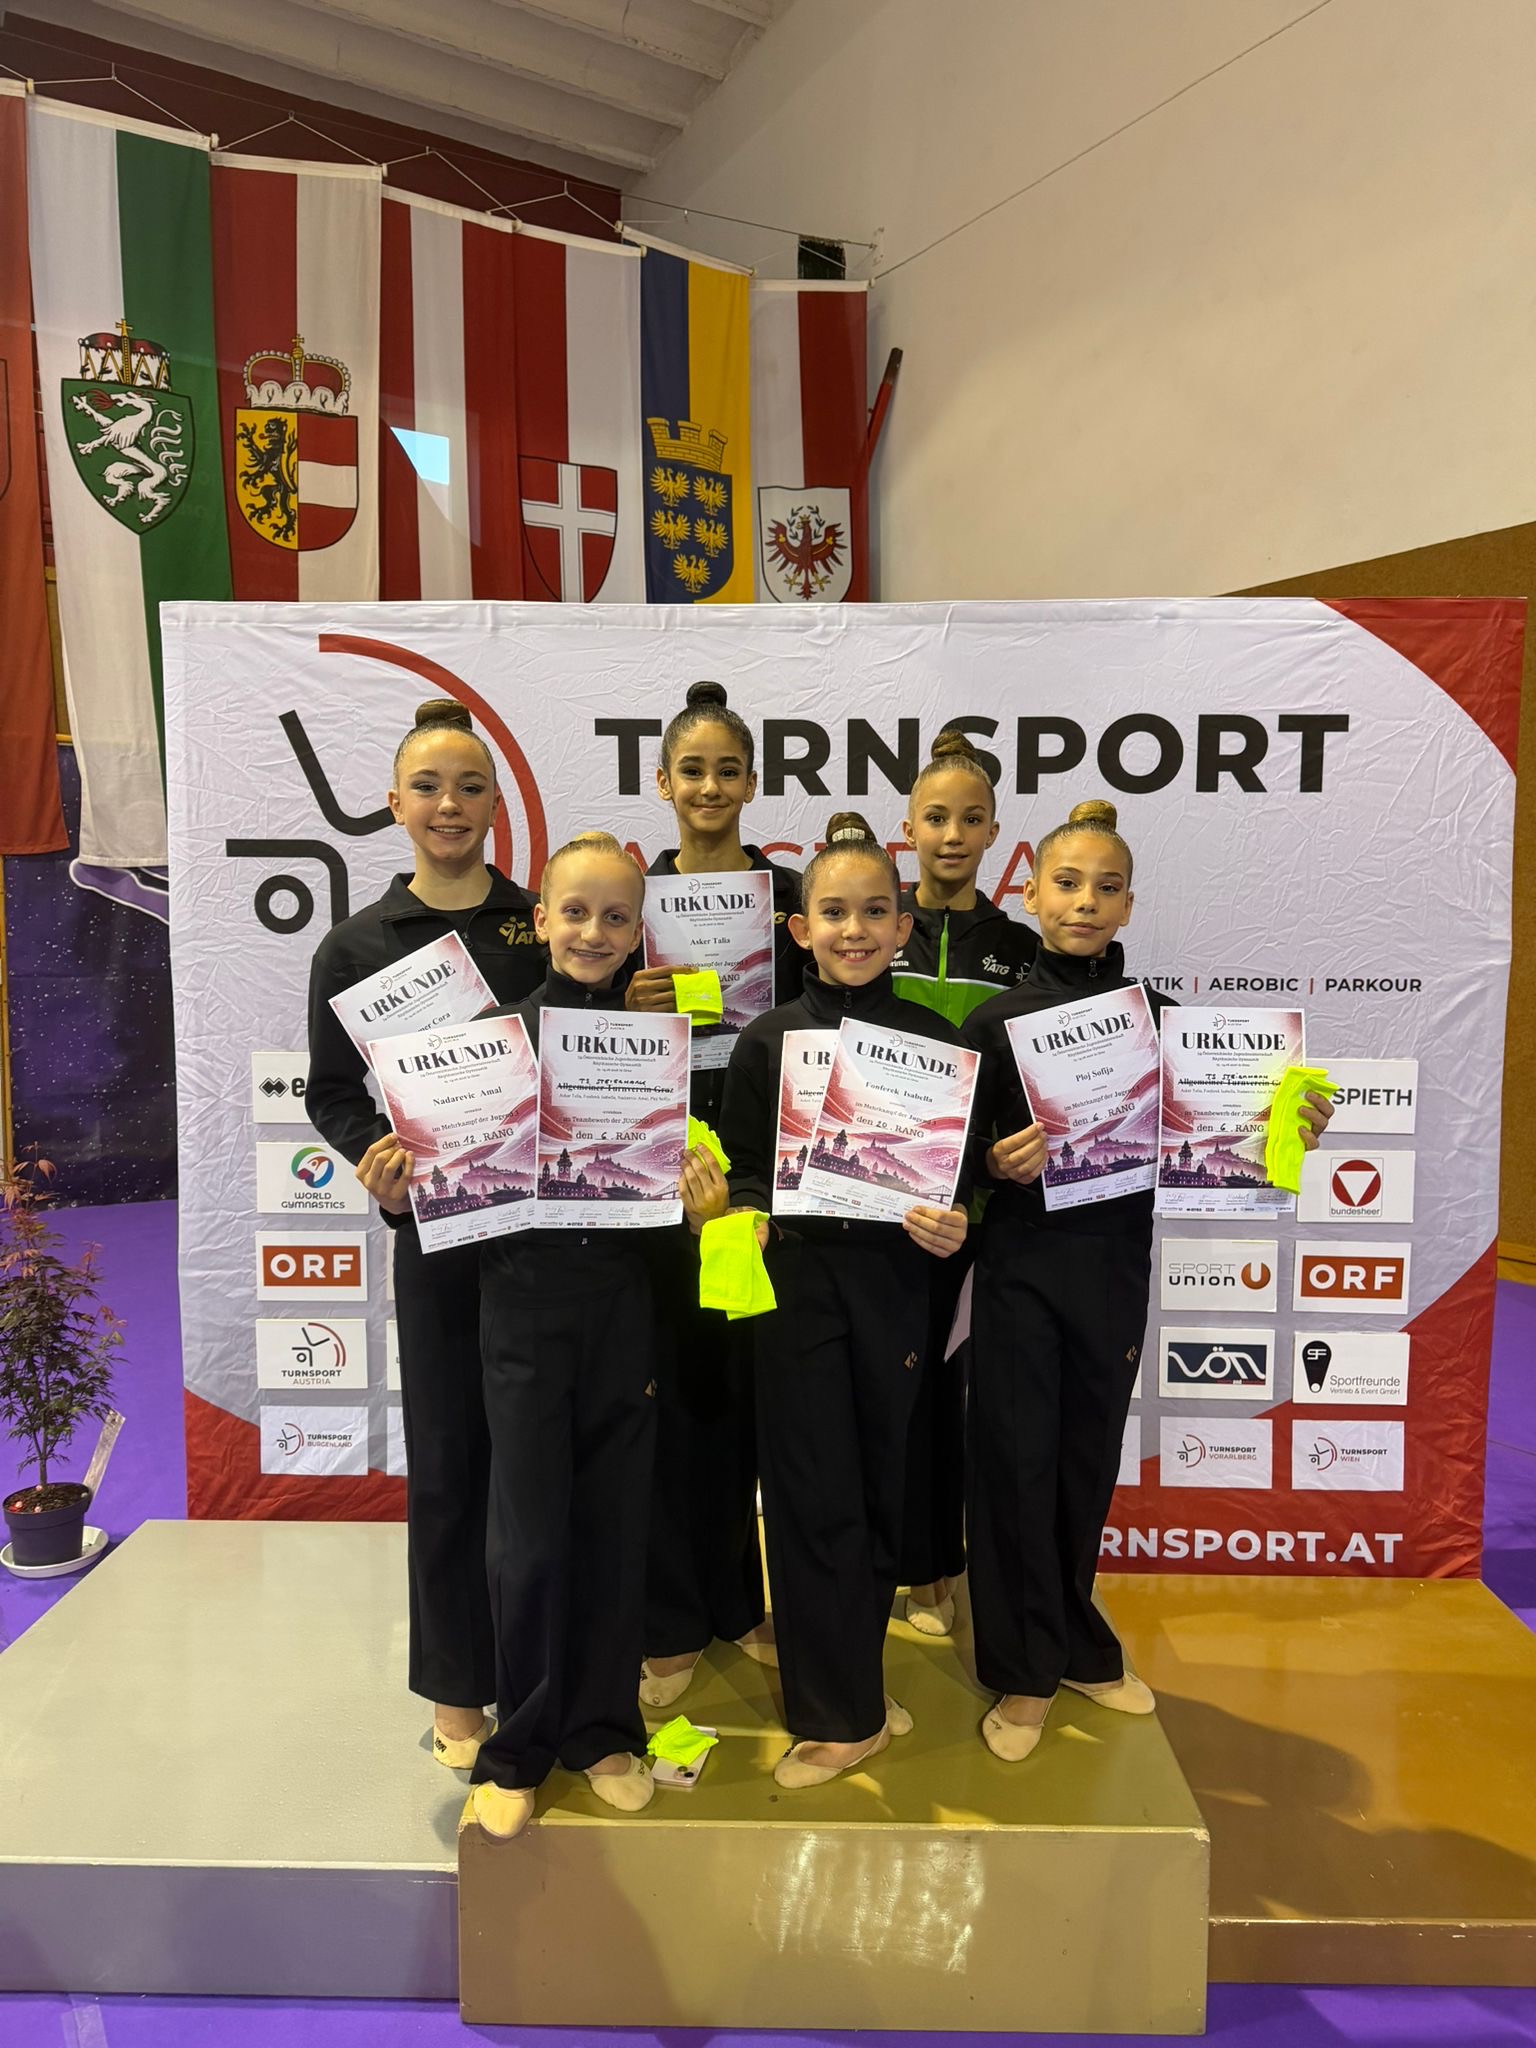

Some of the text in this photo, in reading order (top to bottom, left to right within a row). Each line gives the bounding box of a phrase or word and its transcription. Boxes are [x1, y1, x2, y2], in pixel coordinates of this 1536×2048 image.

[594, 714, 1350, 796] TRNSPORT
[660, 893, 756, 914] URKUNDE
[690, 937, 730, 946] Asker Talia
[989, 964, 1010, 975] ATG
[360, 960, 456, 1023] URKUNDE
[1209, 977, 1299, 992] AEROBIC
[1325, 977, 1422, 993] PARKOUR
[1032, 1012, 1135, 1054] URKUNDE
[1182, 1032, 1286, 1050] URKUNDE
[562, 1034, 670, 1056] URKUNDE
[398, 1039, 512, 1074] URKUNDE
[856, 1041, 958, 1078] URKUNDE
[1092, 1066, 1114, 1078] Sofija
[433, 1086, 502, 1107] Nadarevic Amal
[903, 1090, 933, 1103] Isabella
[1331, 1088, 1412, 1106] SPIETH
[1072, 1117, 1089, 1127] den
[1108, 1102, 1135, 1117] RANG
[576, 1129, 593, 1140] den
[616, 1130, 647, 1141] RANG
[856, 1115, 874, 1126] den
[895, 1125, 924, 1138] RANG
[1197, 1124, 1213, 1132] den
[1235, 1124, 1264, 1133] RANG
[442, 1139, 461, 1150] den
[484, 1127, 514, 1143] RANG
[294, 1192, 332, 1200] WORLD
[1331, 1207, 1380, 1216] bundesheer
[270, 1253, 354, 1279] ORF
[1168, 1263, 1236, 1274] SPORT
[1309, 1264, 1397, 1290] ORF
[1330, 1375, 1400, 1389] Sportfreunde
[1097, 1526, 1403, 1564] RNSPORT.AT
